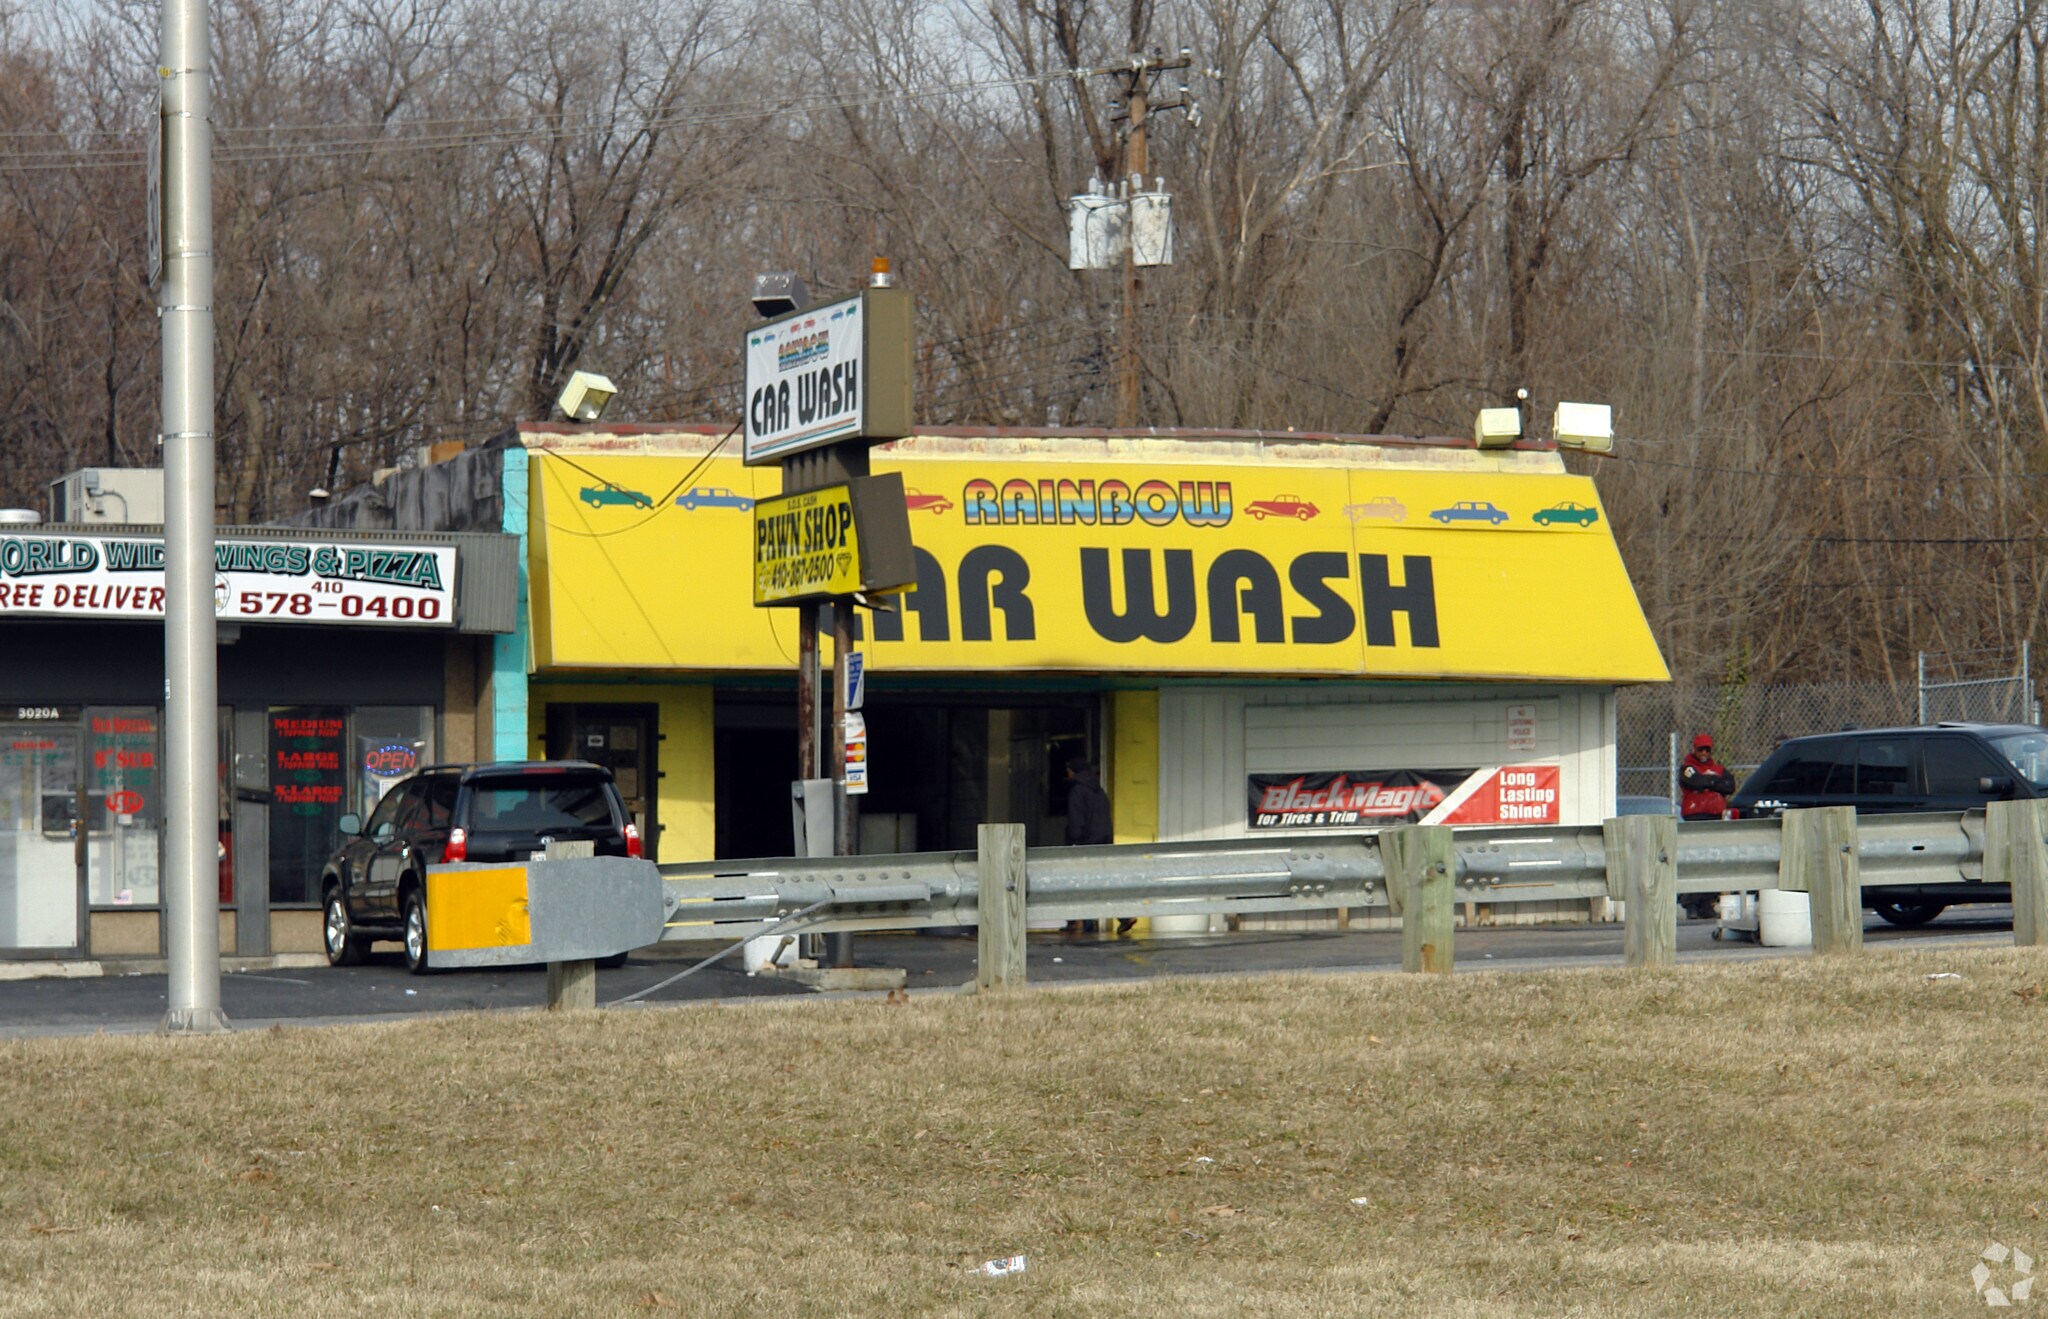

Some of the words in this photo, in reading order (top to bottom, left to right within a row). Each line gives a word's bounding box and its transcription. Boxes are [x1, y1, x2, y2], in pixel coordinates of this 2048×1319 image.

[778, 329, 830, 373] RAINBOW
[751, 387, 790, 437] CAR
[797, 358, 857, 426] WASH
[963, 478, 1234, 528] RAINBOW
[757, 511, 801, 563] PAWN
[805, 502, 851, 553] SHOP
[0, 537, 99, 577] ORLD
[101, 540, 165, 572] WID
[312, 546, 343, 577] &
[341, 547, 444, 592] PIZZA
[311, 581, 343, 594] 410
[850, 544, 1036, 641] AR
[1079, 546, 1440, 648] WASH
[0, 584, 44, 609] REE
[53, 585, 165, 612] DELIVER
[239, 592, 440, 620] 578-0400
[18, 707, 60, 719] 3020A
[274, 718, 343, 730] MEDIUM
[116, 750, 154, 768] SUB
[278, 750, 339, 762] LARGE
[365, 751, 417, 769] OPEN
[1500, 771, 1535, 786] Long
[1262, 778, 1347, 810] Black
[1347, 783, 1438, 813] Magic
[1500, 787, 1554, 803] Lasting
[1256, 813, 1278, 826] for
[1281, 812, 1313, 825] Tires
[1315, 813, 1325, 824] &
[1329, 811, 1359, 824] Trim
[1500, 803, 1547, 819] Shine!
